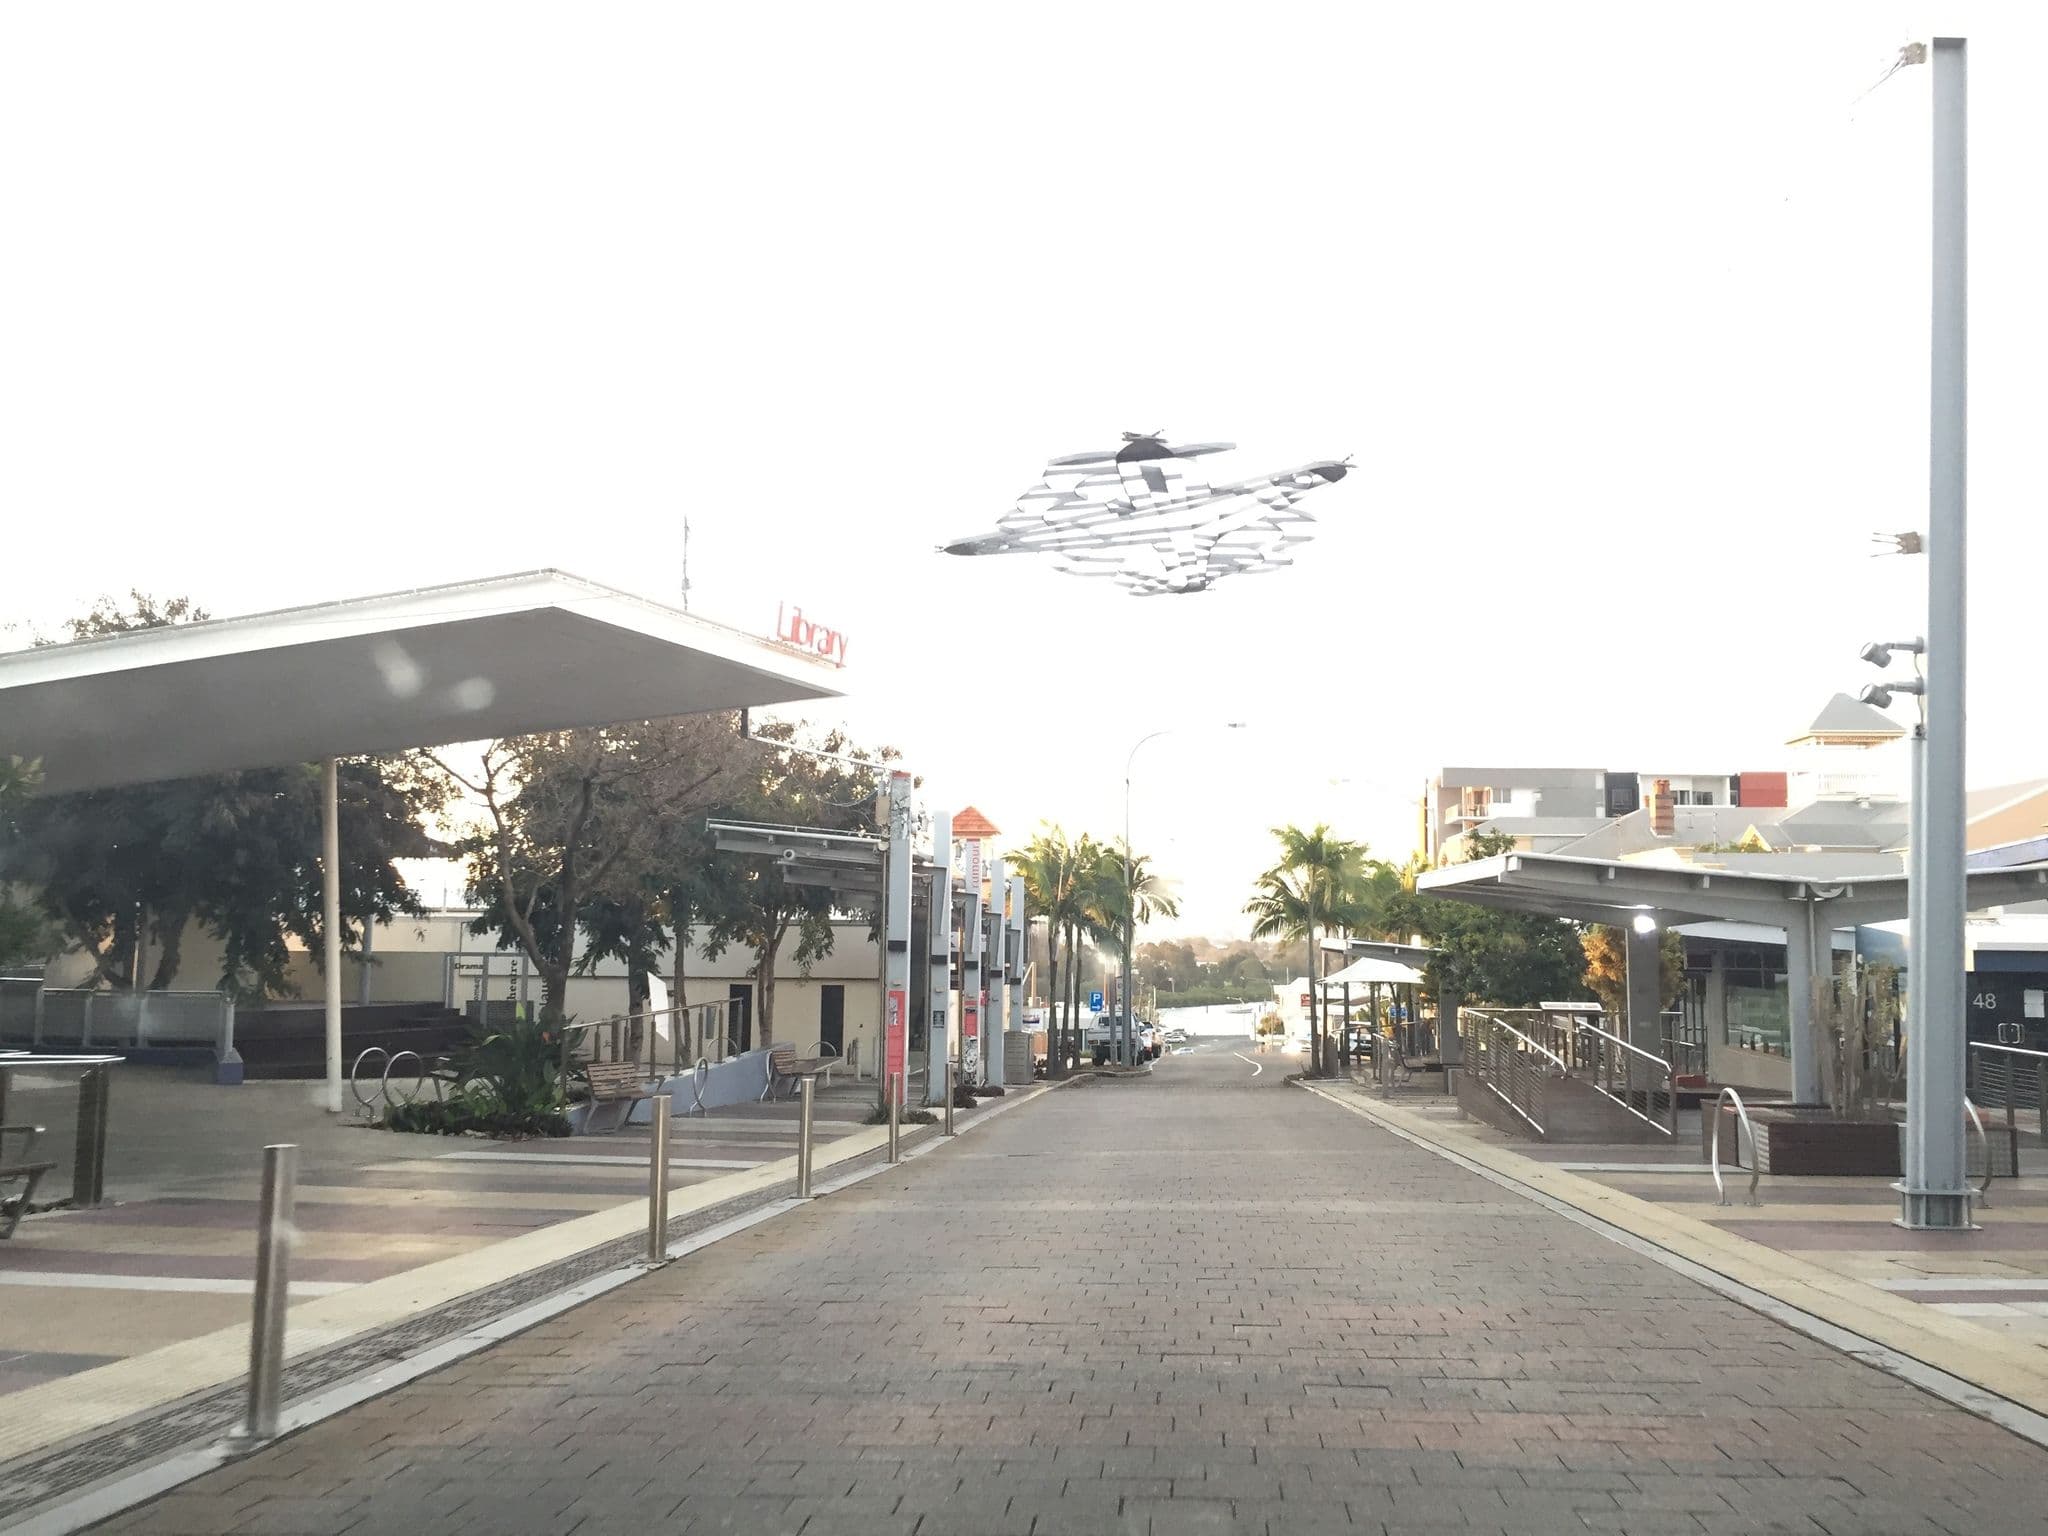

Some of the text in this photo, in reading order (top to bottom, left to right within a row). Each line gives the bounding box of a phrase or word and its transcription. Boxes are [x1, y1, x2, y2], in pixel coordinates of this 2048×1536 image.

[776, 599, 849, 669] Library
[507, 960, 517, 1000] heatre
[1093, 993, 1101, 1004] P
[1972, 992, 1997, 1010] 48
